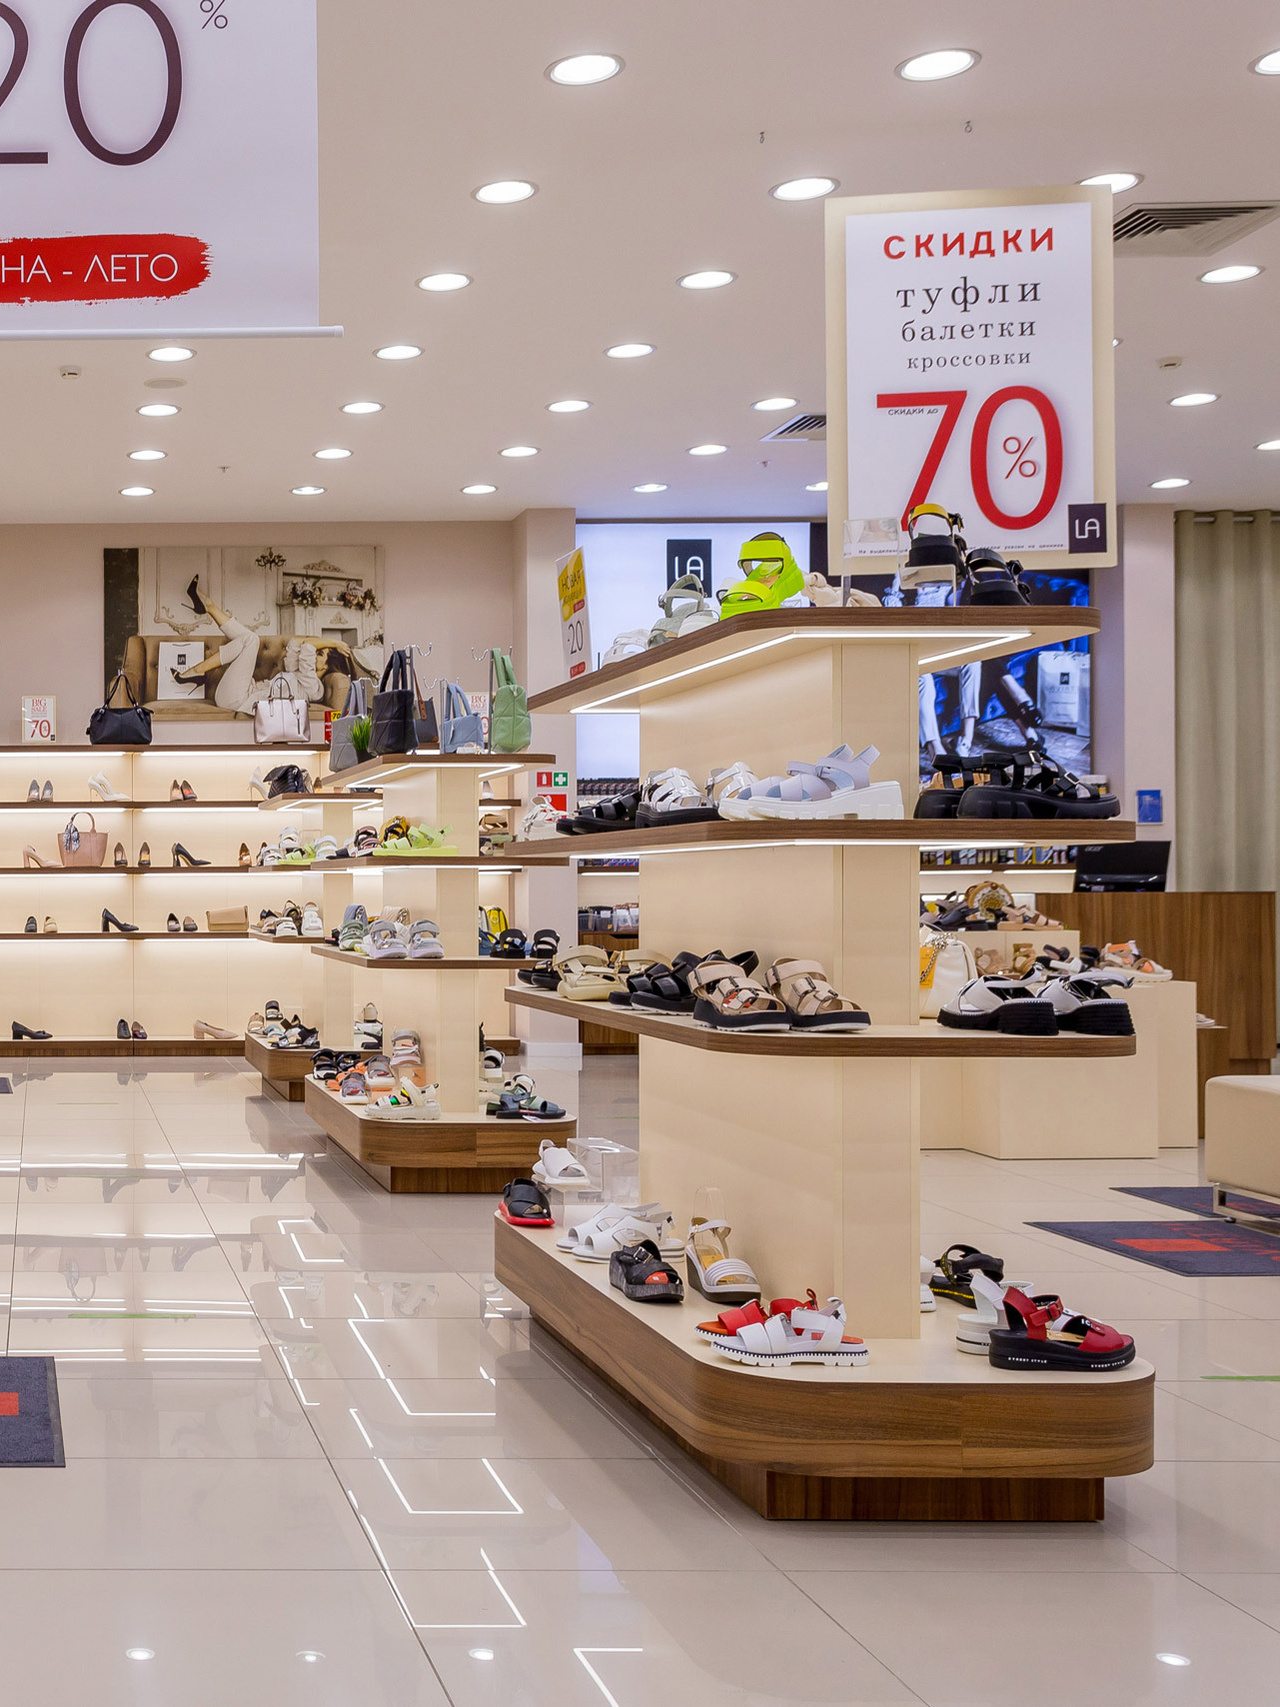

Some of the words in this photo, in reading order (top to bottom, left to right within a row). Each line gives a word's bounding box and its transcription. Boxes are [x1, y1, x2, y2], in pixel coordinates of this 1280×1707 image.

[883, 227, 1054, 260] СКИДКИ
[84, 253, 178, 283] ЛЕТО
[896, 276, 1041, 314] туфли
[901, 319, 1037, 342] балетки
[907, 351, 1031, 373] кроссовки
[876, 385, 1063, 532] 70
[1075, 518, 1101, 539] LA
[675, 556, 704, 582] LA
